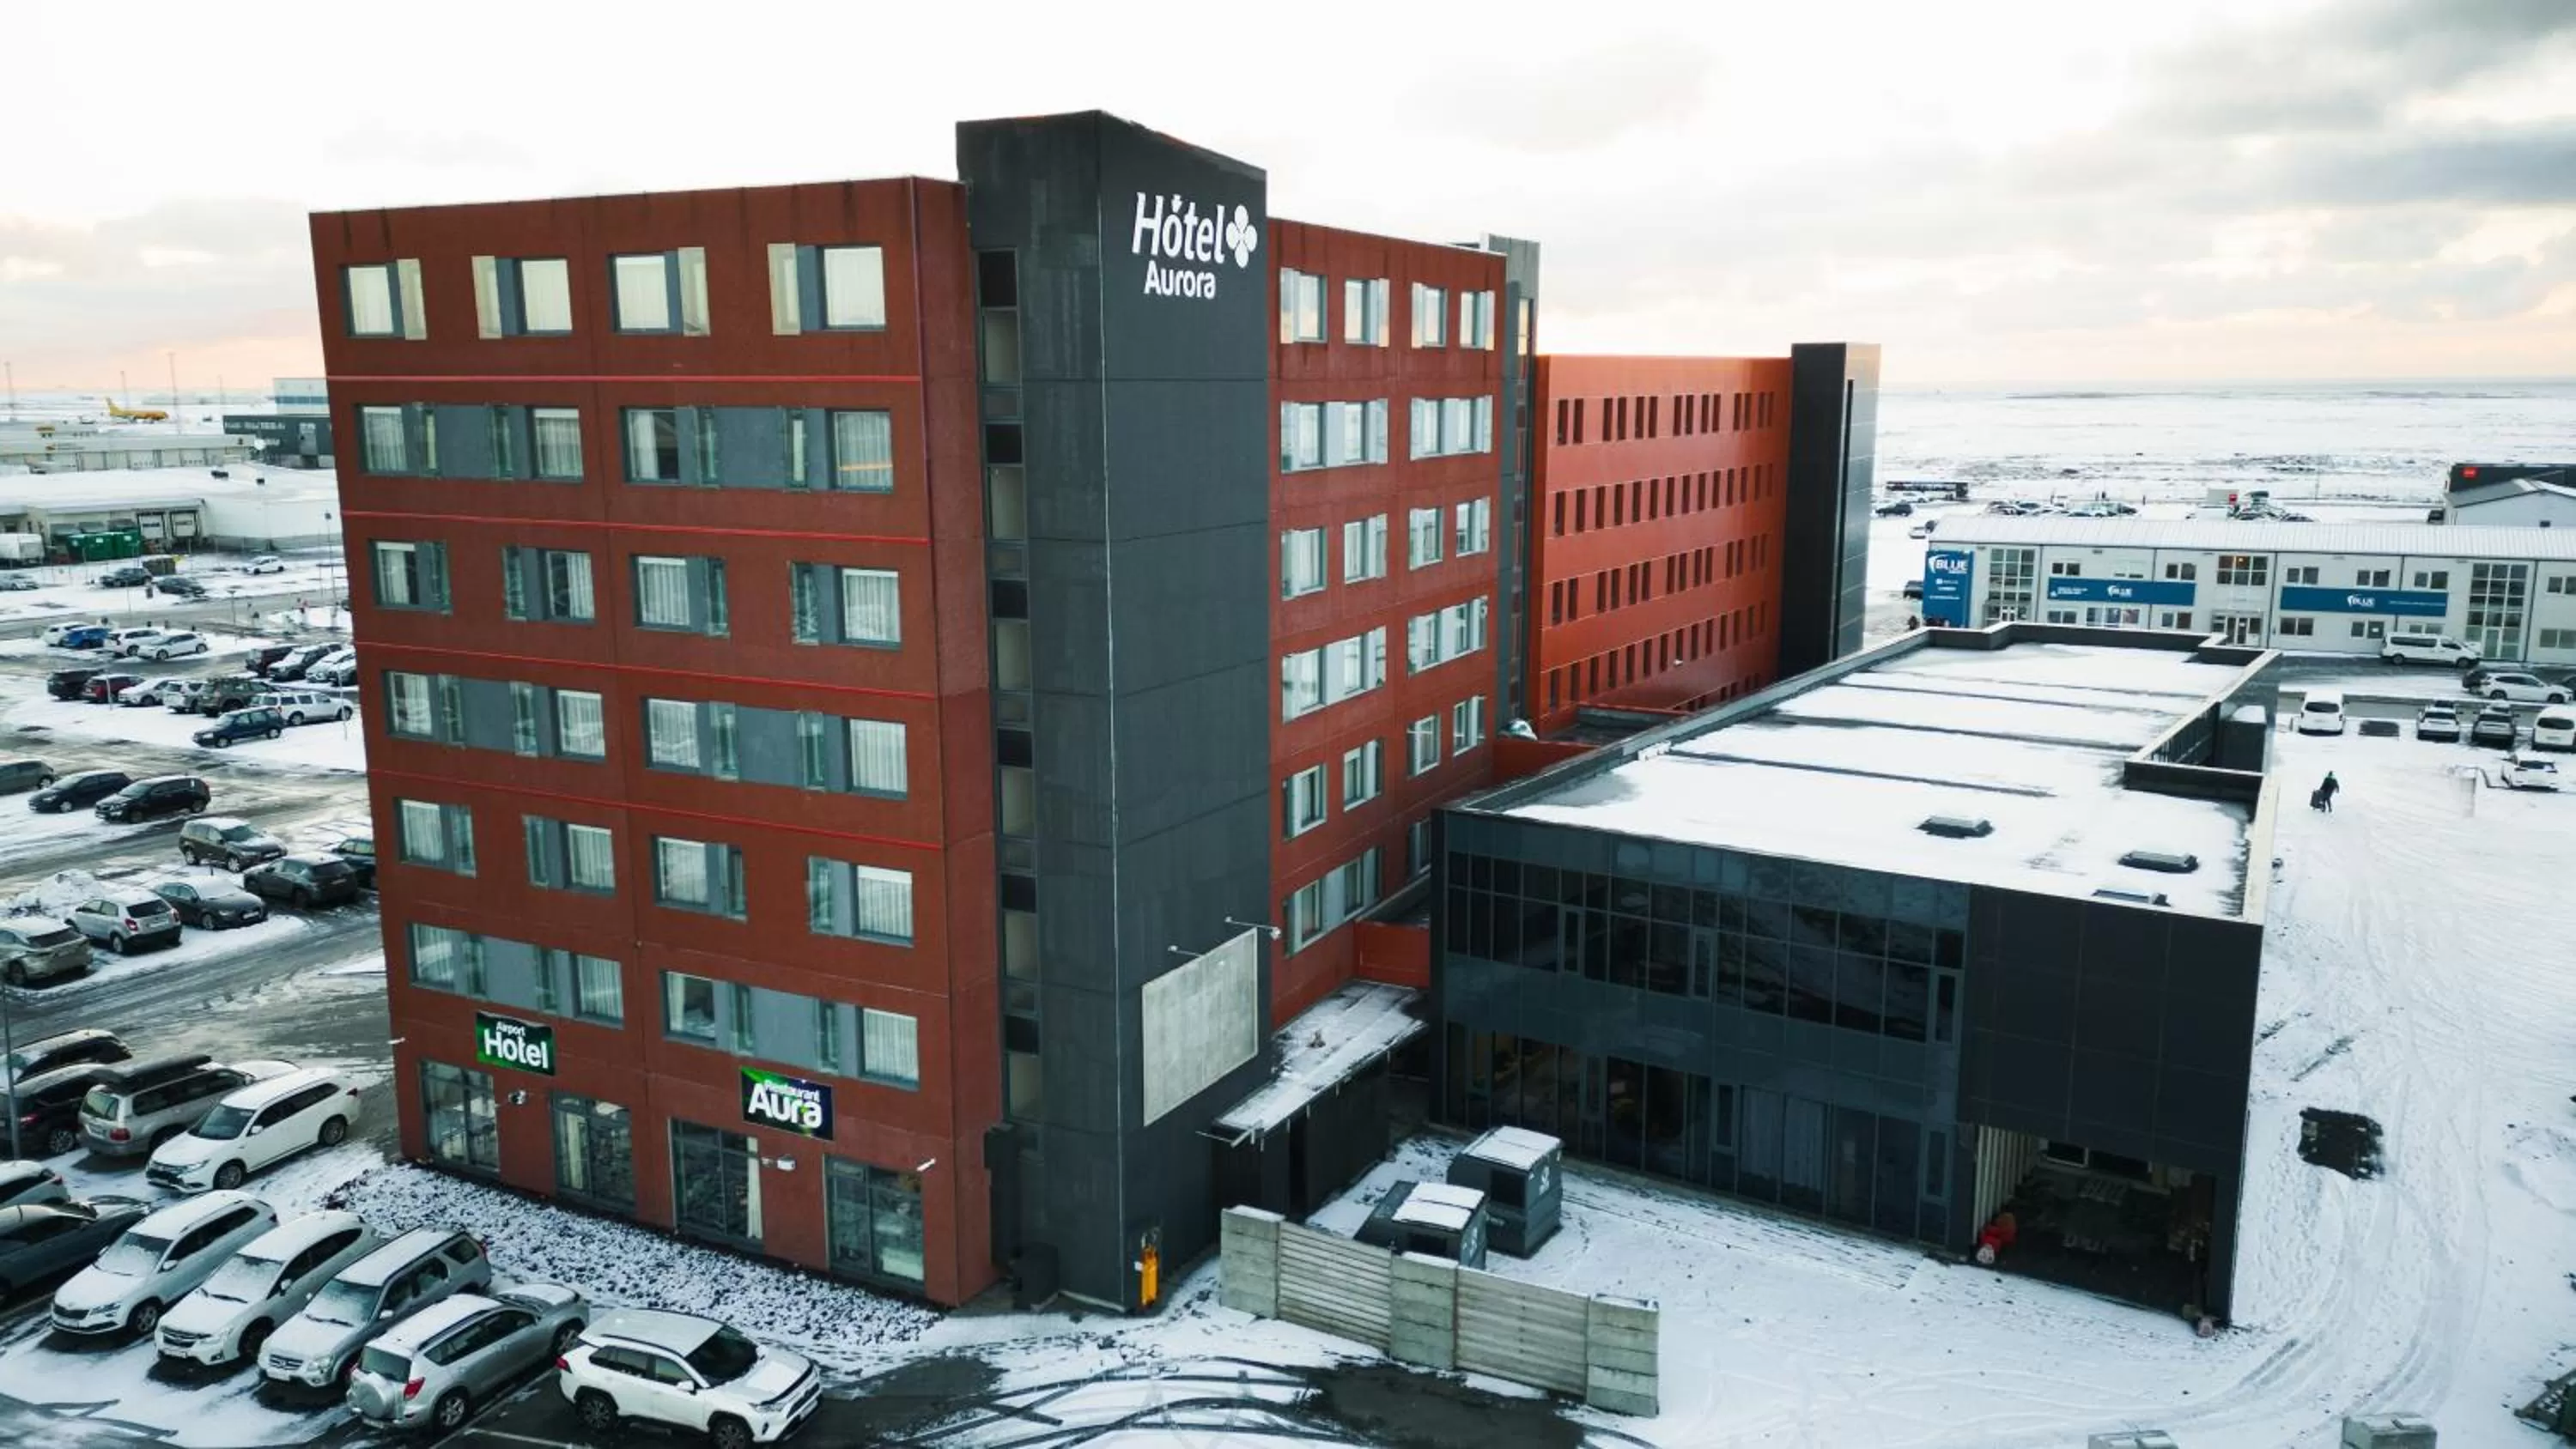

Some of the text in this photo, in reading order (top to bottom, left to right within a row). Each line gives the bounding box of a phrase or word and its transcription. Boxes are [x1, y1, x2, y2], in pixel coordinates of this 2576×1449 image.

[1132, 191, 1225, 264] Hótel
[1144, 259, 1216, 300] Aurora
[1935, 559, 1968, 571] BLUE
[483, 1028, 549, 1069] Hotel
[495, 1021, 526, 1037] Airport
[748, 1082, 822, 1129] Aura
